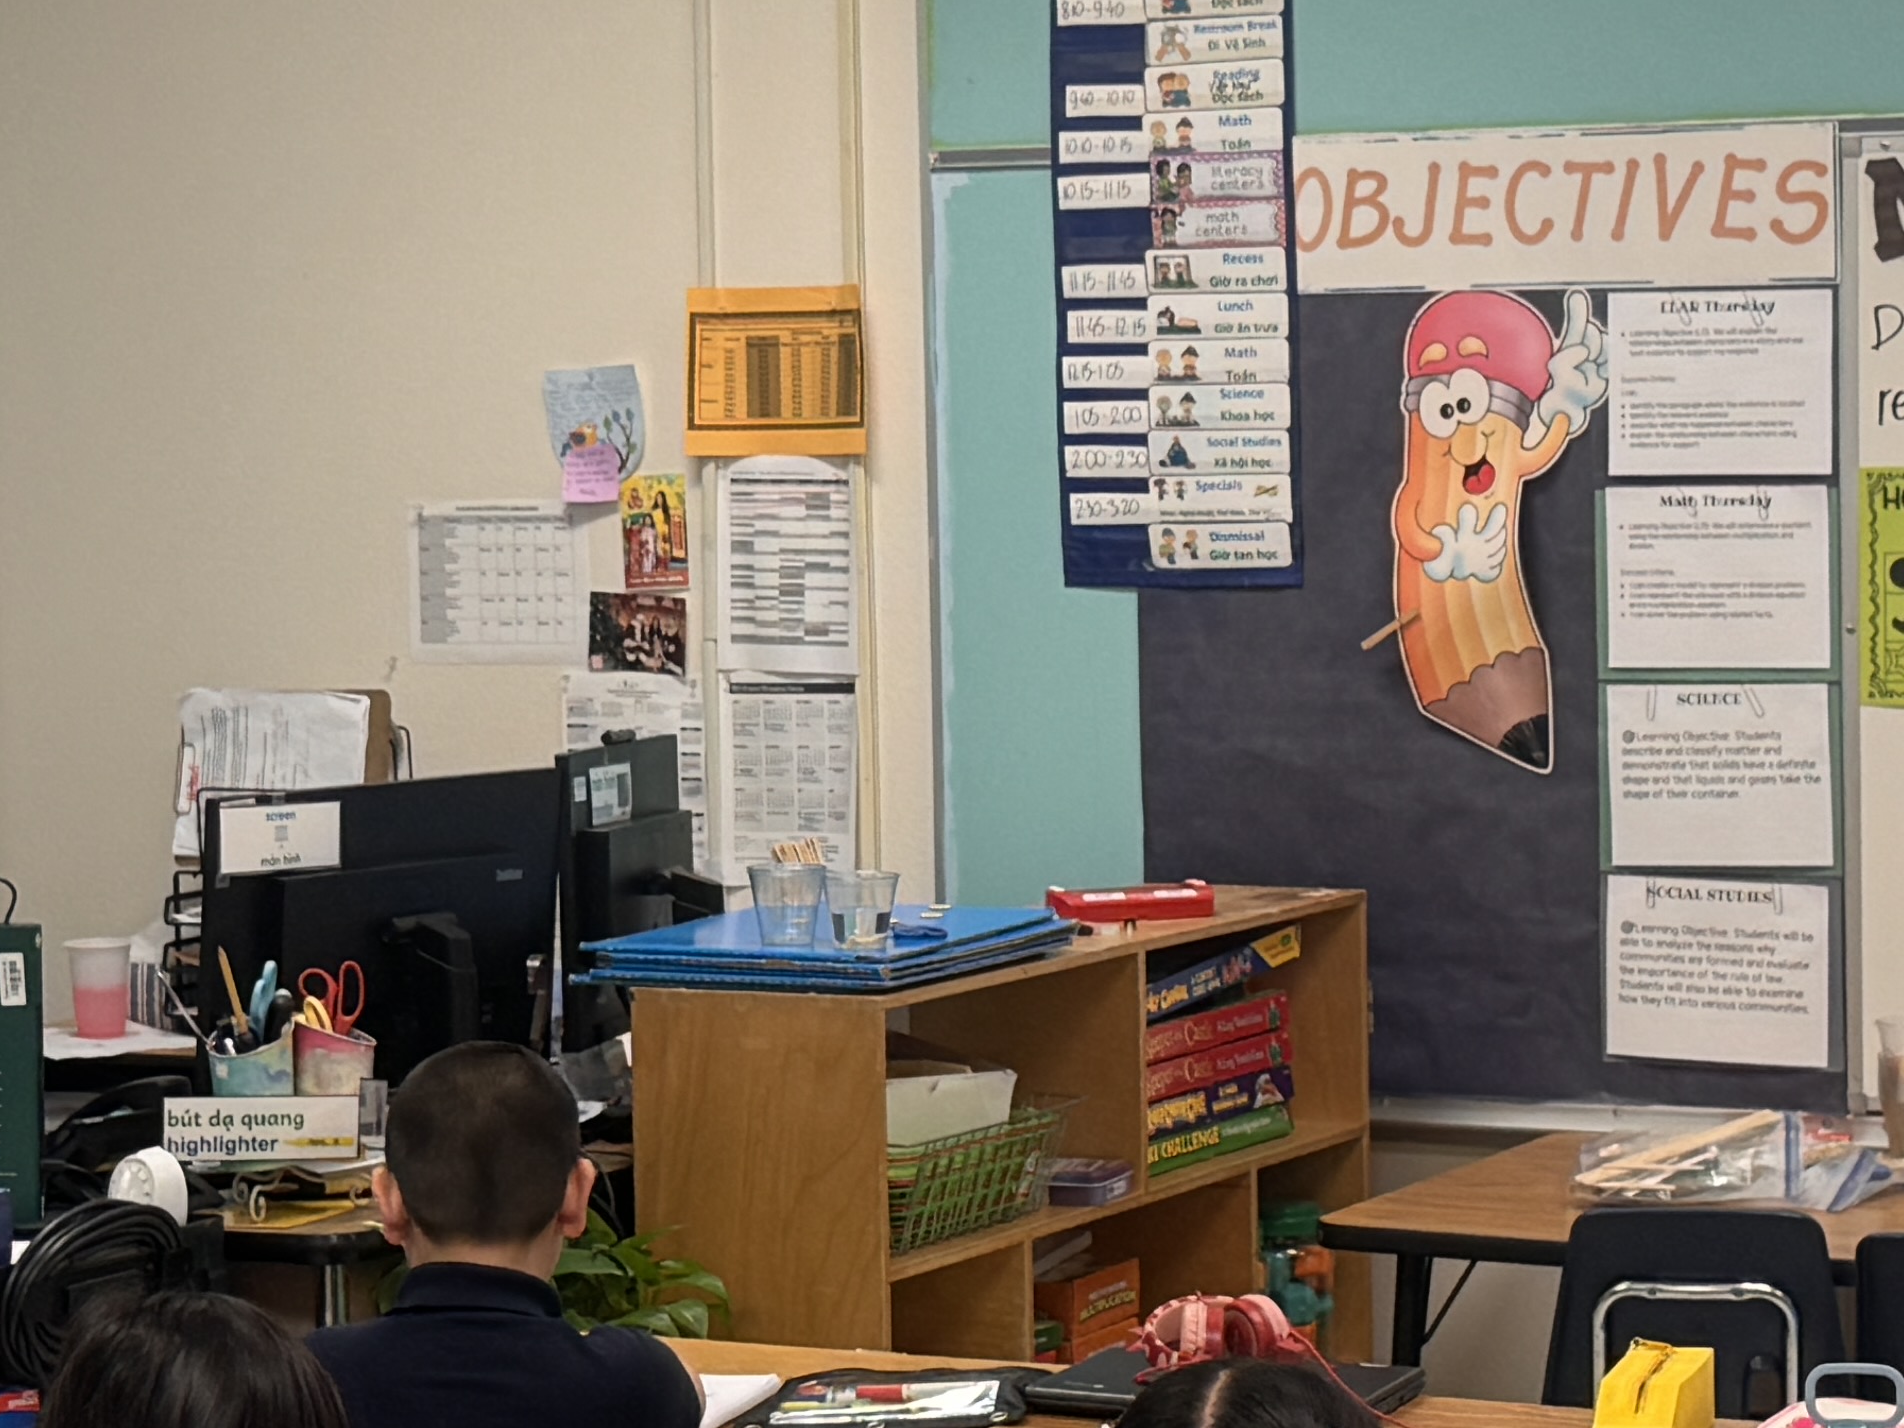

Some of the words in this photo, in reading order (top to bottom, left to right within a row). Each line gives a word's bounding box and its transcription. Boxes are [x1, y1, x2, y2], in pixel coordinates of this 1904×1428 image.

[1218, 115, 1252, 128] Math
[1211, 166, 1264, 180] literacy
[1211, 178, 1264, 191] centers
[1295, 153, 1831, 254] OBJECTIVES
[1205, 212, 1240, 223] math
[1195, 223, 1247, 238] centers
[1222, 253, 1264, 265] Recess
[1209, 275, 1232, 288] Giờ
[1251, 274, 1279, 286] chơi
[1217, 301, 1254, 312] Lunch
[1705, 299, 1776, 317] Thursday
[1224, 347, 1257, 359] Math
[1219, 388, 1264, 400] Science
[1220, 411, 1250, 422] Khoa
[1254, 411, 1275, 424] học
[1207, 437, 1238, 448] Social
[1242, 436, 1282, 447] Studies
[1251, 457, 1271, 470] học
[1196, 479, 1243, 493] Specials
[1660, 493, 1698, 509] Math
[1702, 493, 1773, 512] Thursday
[1209, 531, 1265, 542] Dismissal
[1209, 549, 1231, 561] Giờ
[1257, 549, 1278, 562] học
[266, 811, 297, 822] screen
[261, 854, 281, 867] màn
[282, 851, 302, 865] hình
[1647, 886, 1704, 900] SOCIAL
[167, 1109, 202, 1128] bút
[208, 1109, 235, 1132] dạ
[241, 1112, 305, 1131] quang
[167, 1136, 279, 1156] highlighter
[1161, 1127, 1220, 1157] CHALLENGE
